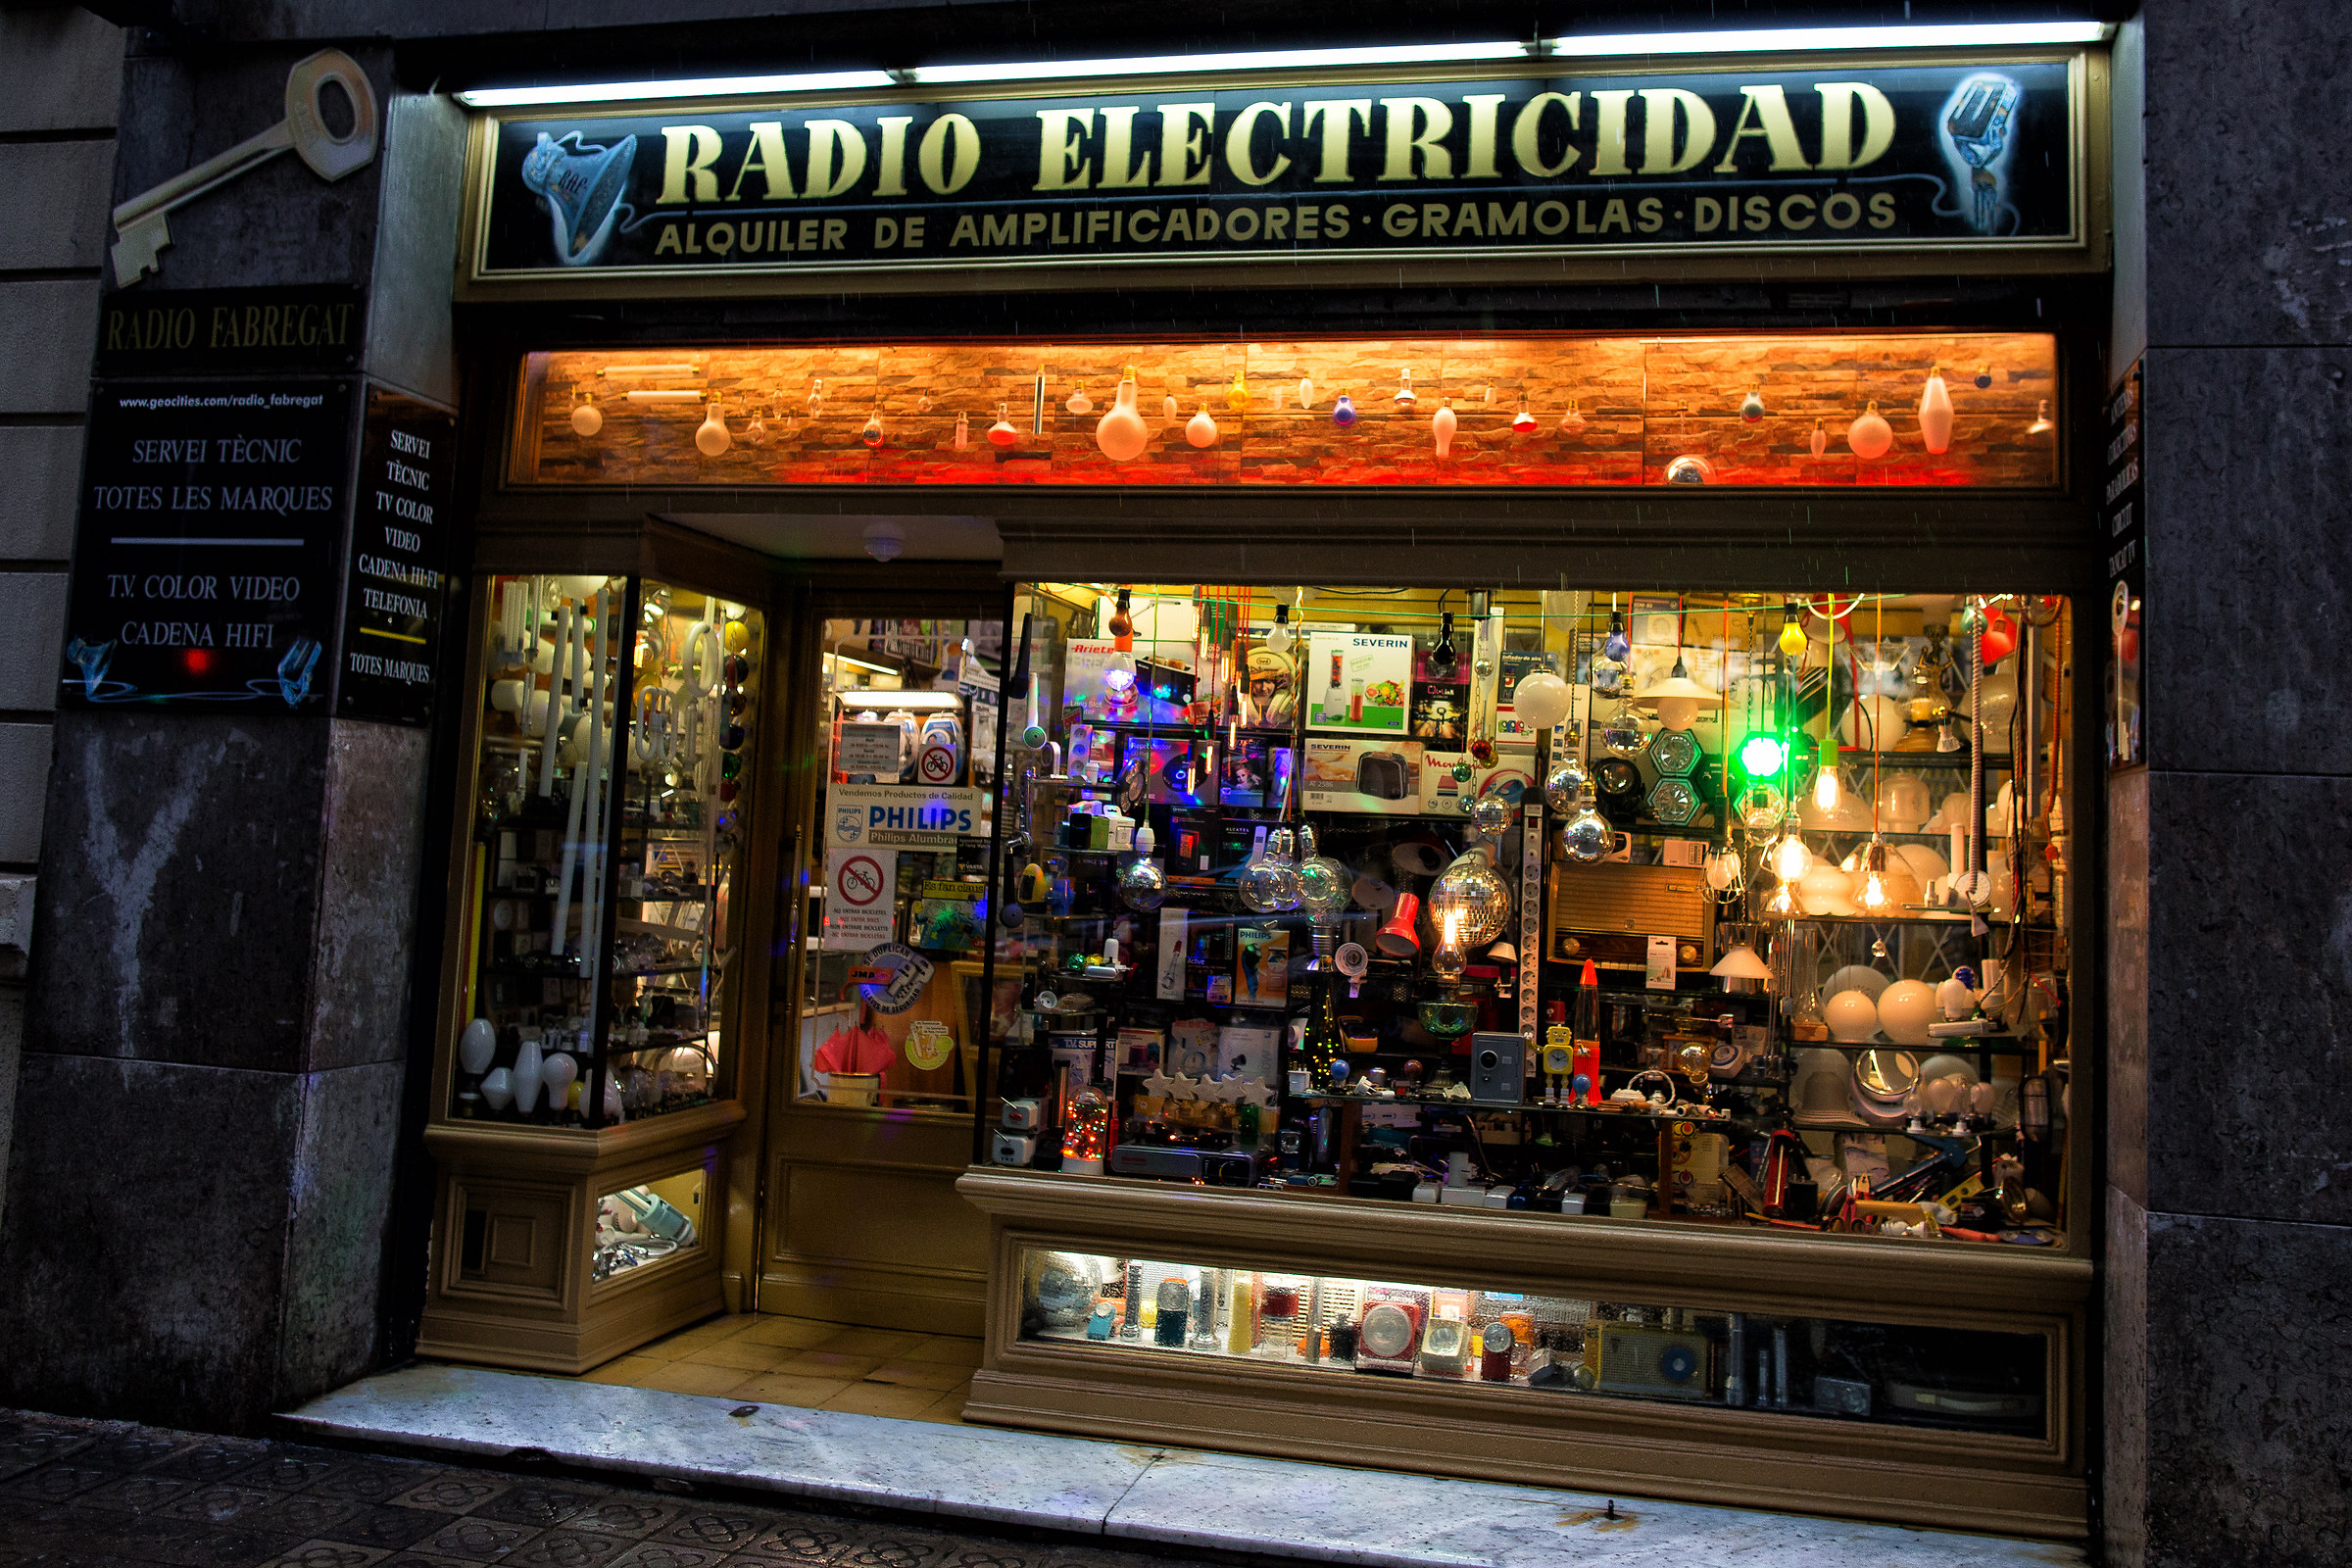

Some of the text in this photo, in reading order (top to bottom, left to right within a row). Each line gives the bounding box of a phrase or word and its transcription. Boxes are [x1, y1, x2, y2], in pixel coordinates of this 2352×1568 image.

[657, 81, 1896, 204] RADIO ELECTRICIDAD
[655, 192, 1897, 256] ALQUILER DE AMPLIFICADORES GRAMOLAS DISCOS
[106, 303, 355, 351] RADIO FABREGAT
[119, 393, 324, 411] www.geocities.com/radio_fabregat
[132, 434, 303, 464] SERVEI TÈCNIC
[390, 429, 431, 461] SERVEI
[387, 460, 430, 492] TÈCNIC
[94, 486, 333, 516] TOTES LES MARQUES
[375, 491, 433, 525] TV COLOR
[384, 526, 420, 554] VIDEO
[359, 553, 408, 583] CADENA
[145, 574, 219, 600] COLOR
[229, 576, 301, 601] VIDEO
[364, 587, 428, 619] TELEFONIA
[122, 620, 274, 649] CADENA HIFI
[1352, 637, 1408, 649] SEVERIN
[1072, 644, 1115, 655] Ariete
[350, 652, 430, 686] TOTES MARQUES
[838, 788, 973, 801] Vendemos Productos de Calidad
[869, 806, 972, 831] PHILIPS
[870, 832, 906, 844] Philips
[924, 881, 984, 894] Es fan claus
[1240, 931, 1272, 940] PHILIPS
[863, 945, 910, 967] SE DUPLICAN
[851, 970, 875, 979] JMA
[863, 989, 881, 1010] LLAVES
[891, 988, 920, 1013] SEGURIDAD
[1078, 1041, 1115, 1050] SUPRT
